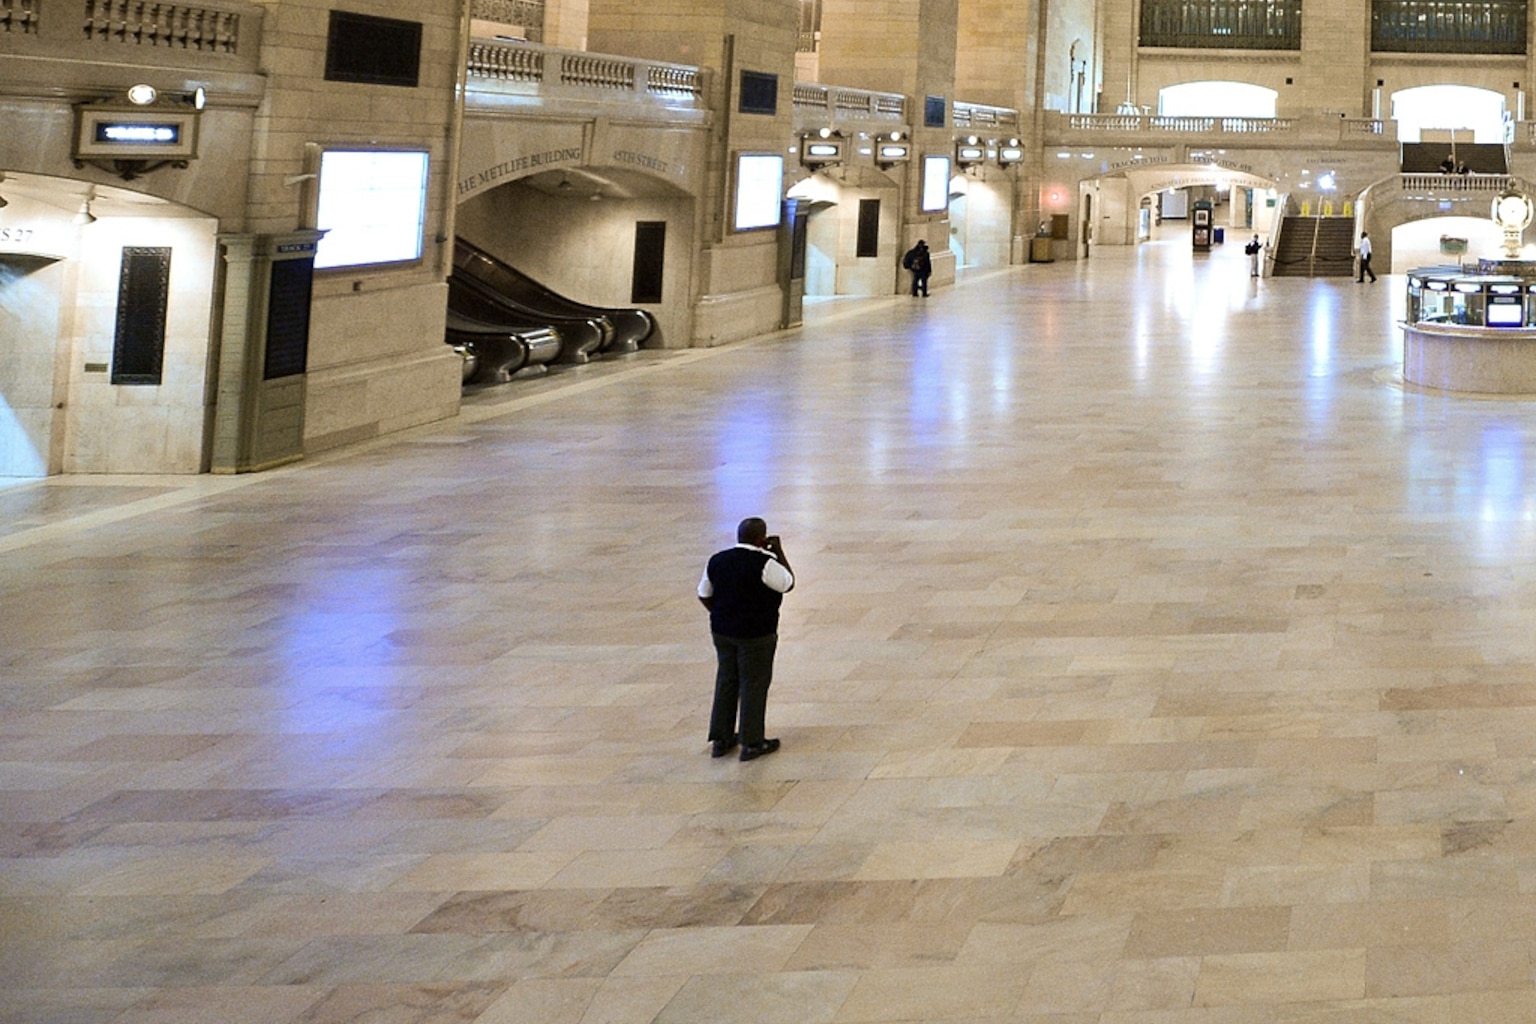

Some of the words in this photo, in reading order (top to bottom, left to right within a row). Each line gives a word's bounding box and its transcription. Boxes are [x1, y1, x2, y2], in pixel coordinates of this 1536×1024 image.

[458, 175, 477, 194] HE
[478, 156, 529, 185] METLIFE
[530, 147, 580, 167] BUILDING
